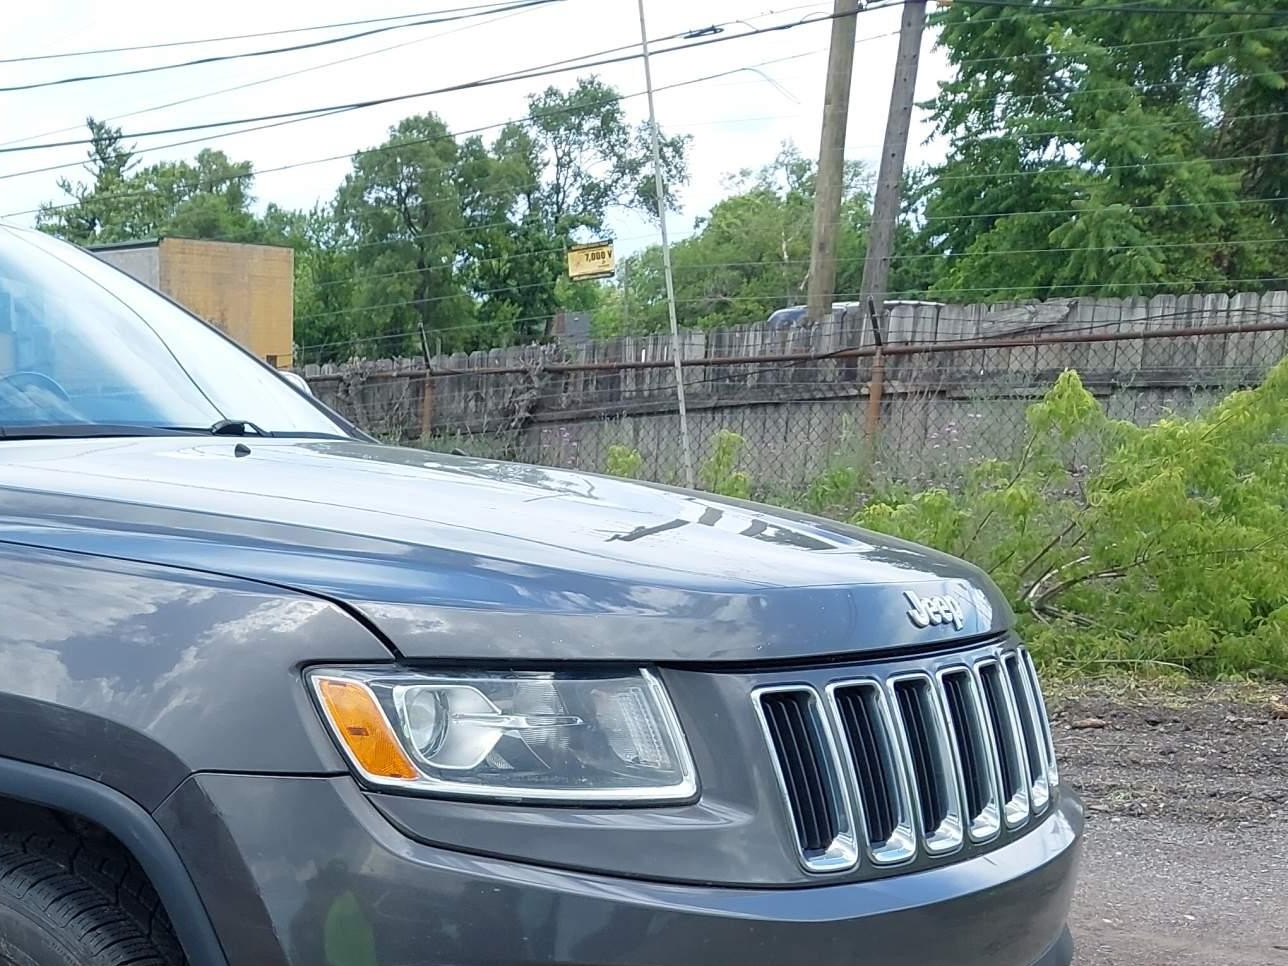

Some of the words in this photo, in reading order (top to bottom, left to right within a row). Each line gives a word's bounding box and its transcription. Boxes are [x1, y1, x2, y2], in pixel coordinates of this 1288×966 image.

[584, 251, 606, 263] 7,000
[607, 250, 612, 259] V
[902, 590, 965, 632] Jeep
